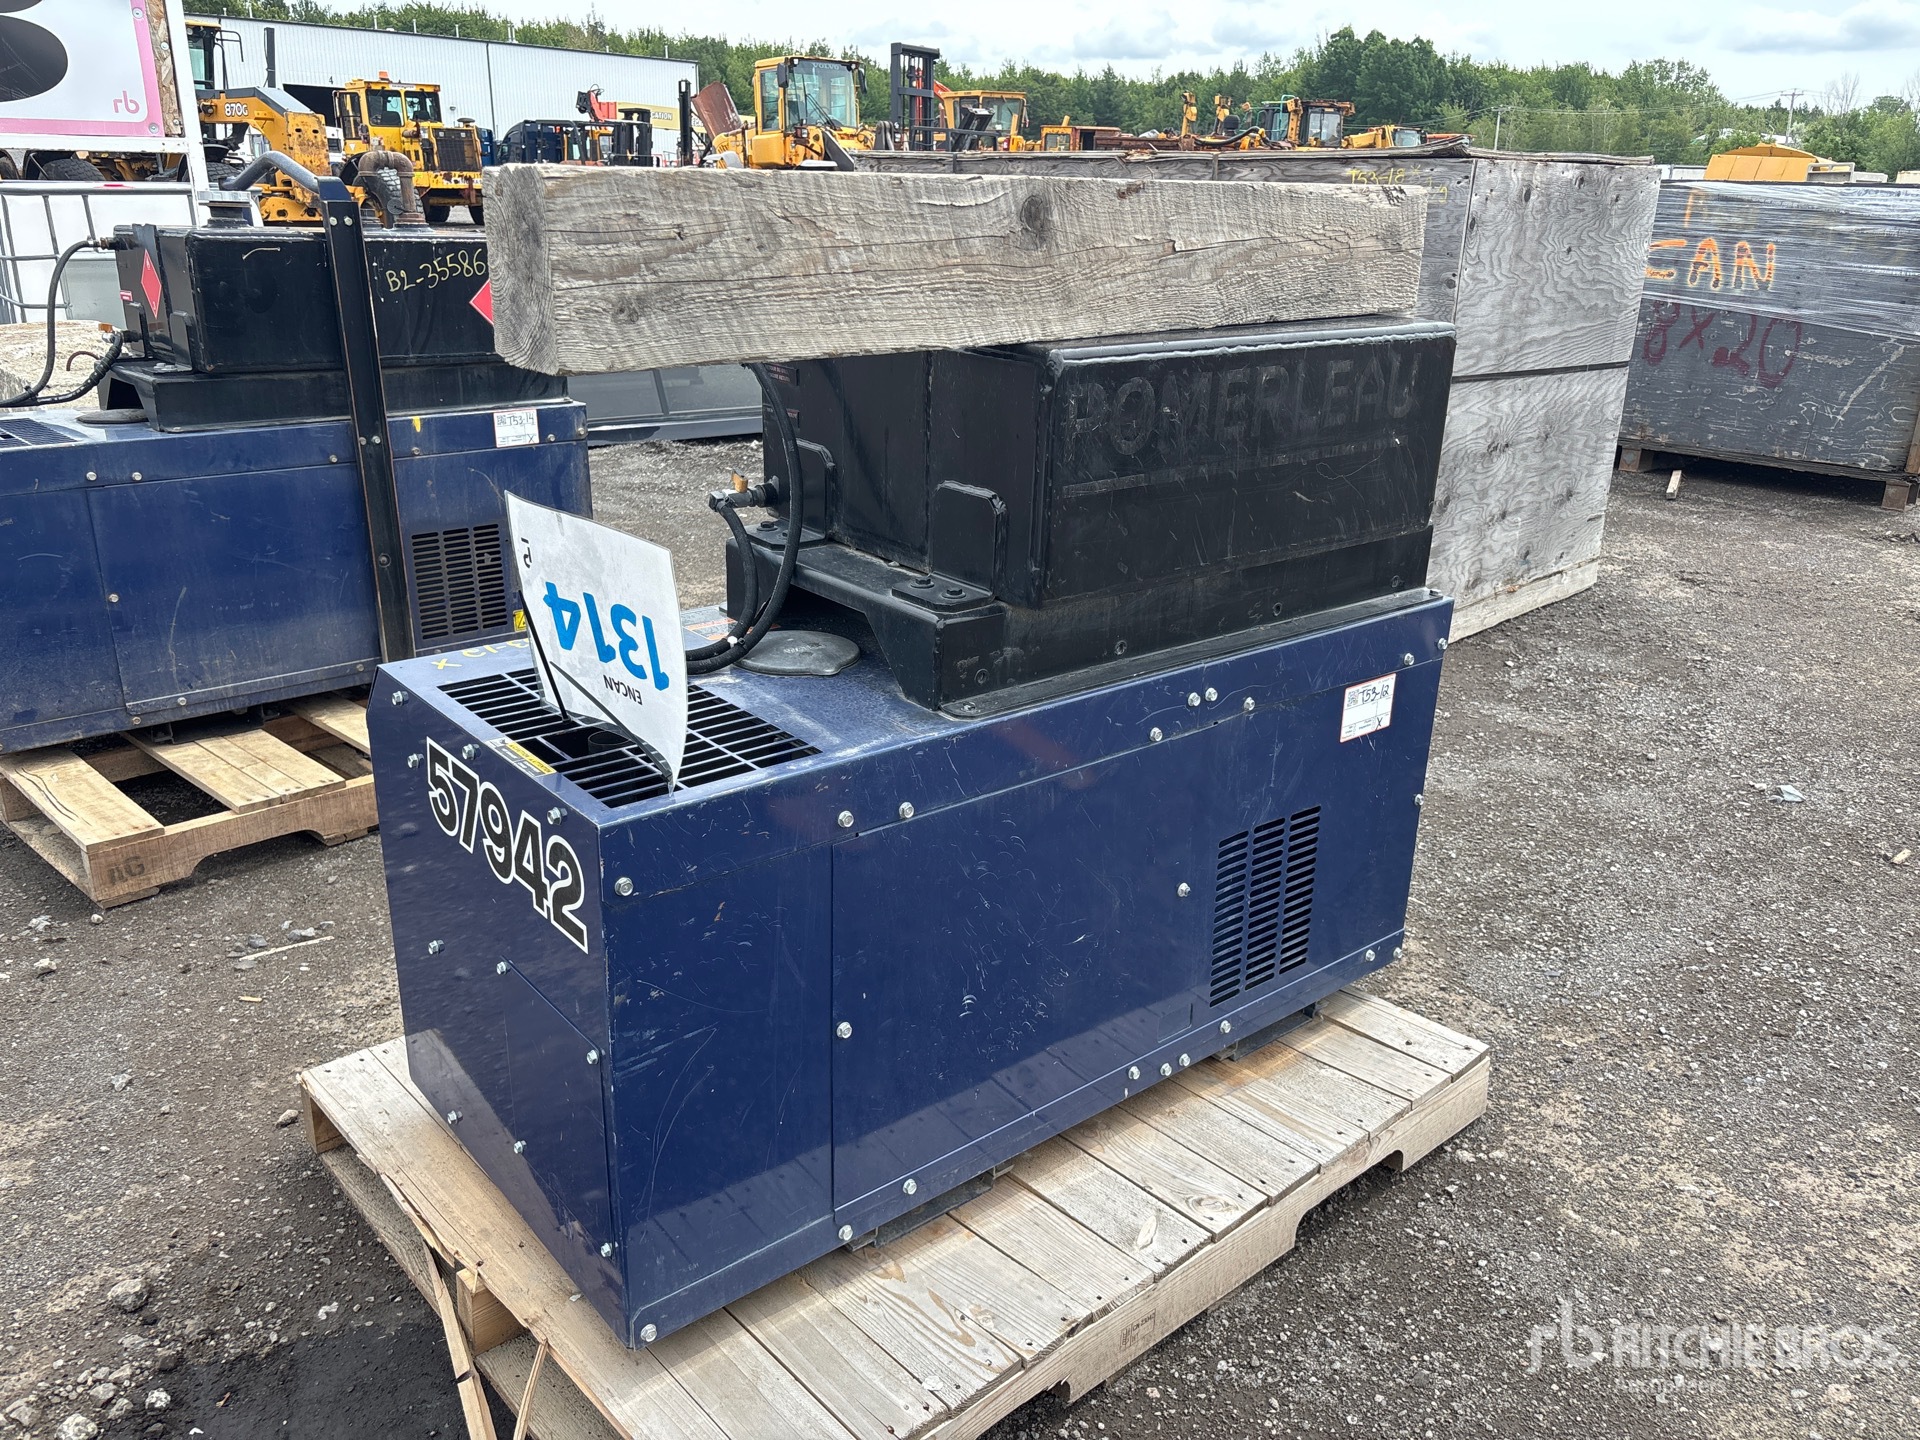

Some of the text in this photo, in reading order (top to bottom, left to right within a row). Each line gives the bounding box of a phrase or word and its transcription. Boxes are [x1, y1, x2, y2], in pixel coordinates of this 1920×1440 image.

[812, 63, 840, 71] VOLVO
[112, 90, 140, 115] rb
[224, 102, 249, 117] 870G
[385, 248, 486, 292] B2-35586
[1066, 350, 1422, 463] POMERLEAU
[543, 581, 671, 692] 1314
[603, 673, 645, 706] ENCAN
[426, 736, 590, 955] 57942
